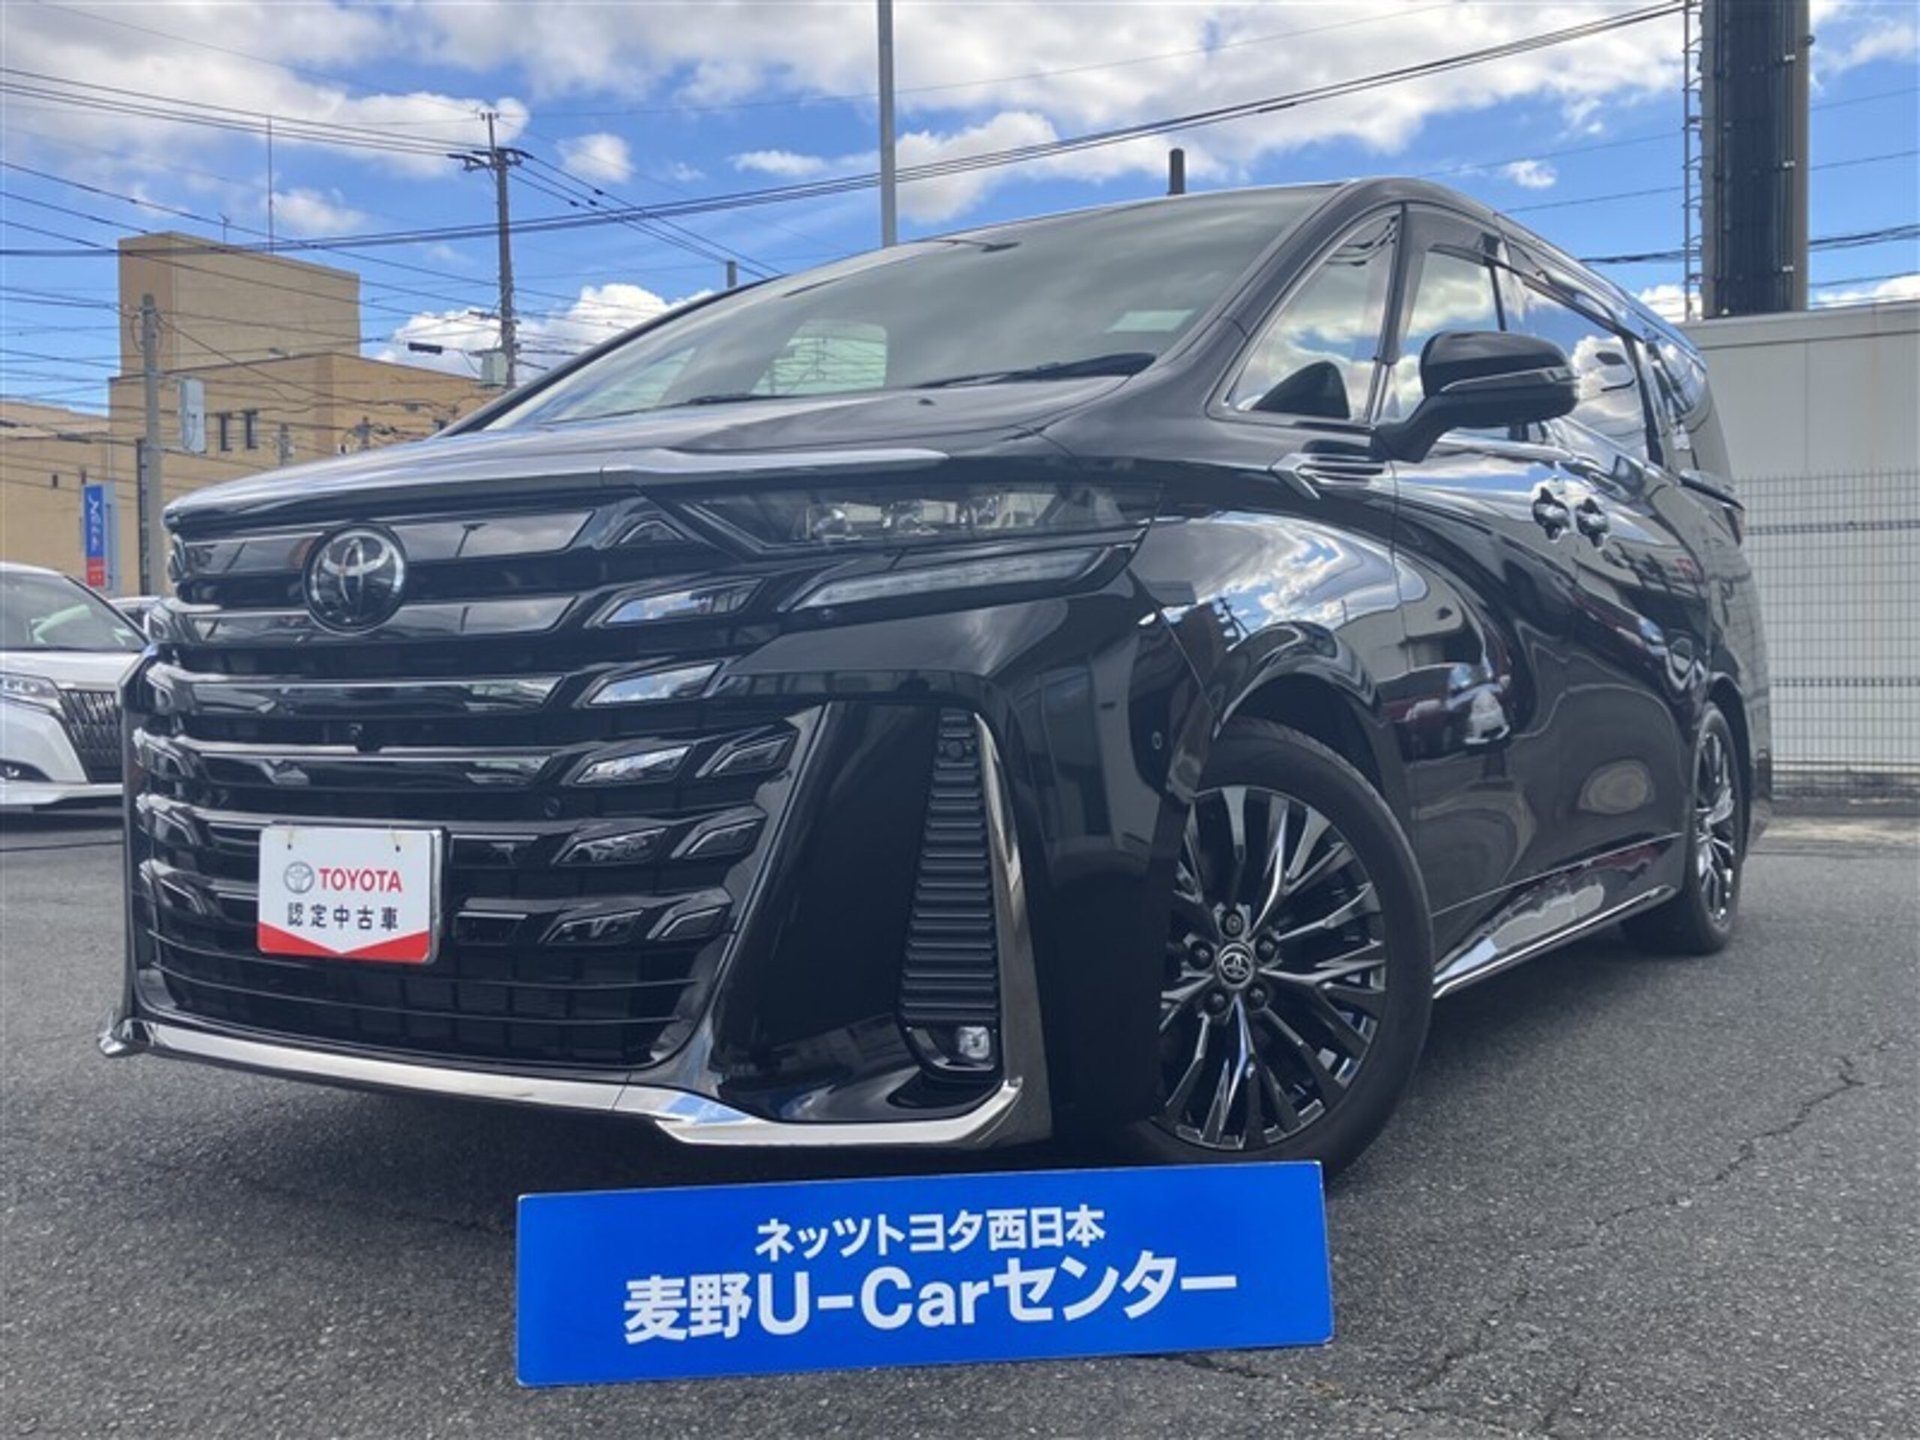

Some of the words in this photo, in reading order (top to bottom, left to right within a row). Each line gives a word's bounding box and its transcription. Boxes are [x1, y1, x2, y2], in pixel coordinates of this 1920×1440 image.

[319, 867, 403, 892] TOYOTA
[287, 902, 399, 930] 認定中古車
[755, 1204, 1106, 1261] ネッツトヨタ西日本
[623, 1250, 1237, 1344] 麦野U-Carセンター
